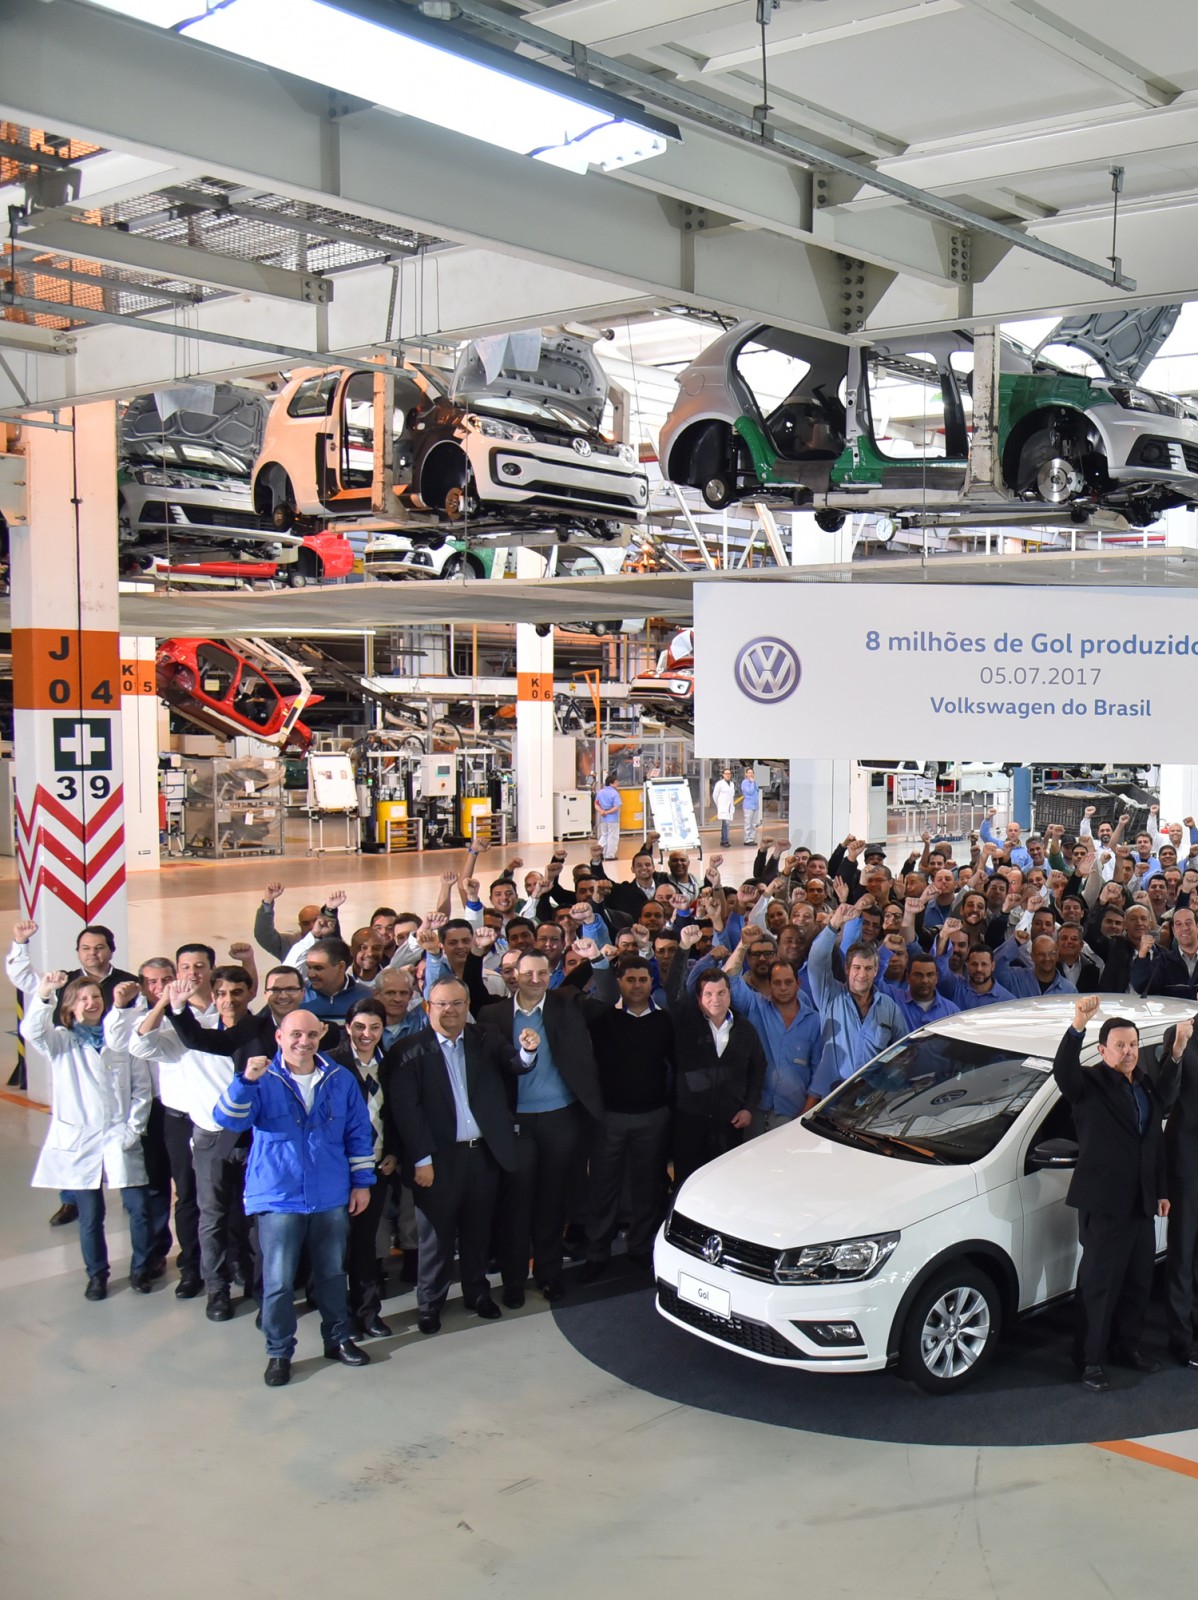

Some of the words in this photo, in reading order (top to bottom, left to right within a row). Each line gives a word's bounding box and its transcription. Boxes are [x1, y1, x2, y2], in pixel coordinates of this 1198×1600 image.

[48, 635, 70, 661] J
[865, 630, 881, 651] 8
[888, 631, 987, 653] milhões
[993, 632, 1024, 653] de
[1031, 633, 1073, 654] Gol
[122, 664, 134, 676] K
[980, 666, 1102, 685] 05.07.2017
[531, 678, 539, 687] K
[930, 697, 1056, 720] Volkswagen
[1062, 698, 1088, 716] do
[1094, 698, 1152, 717] Brasil
[698, 1288, 709, 1300] Gol
